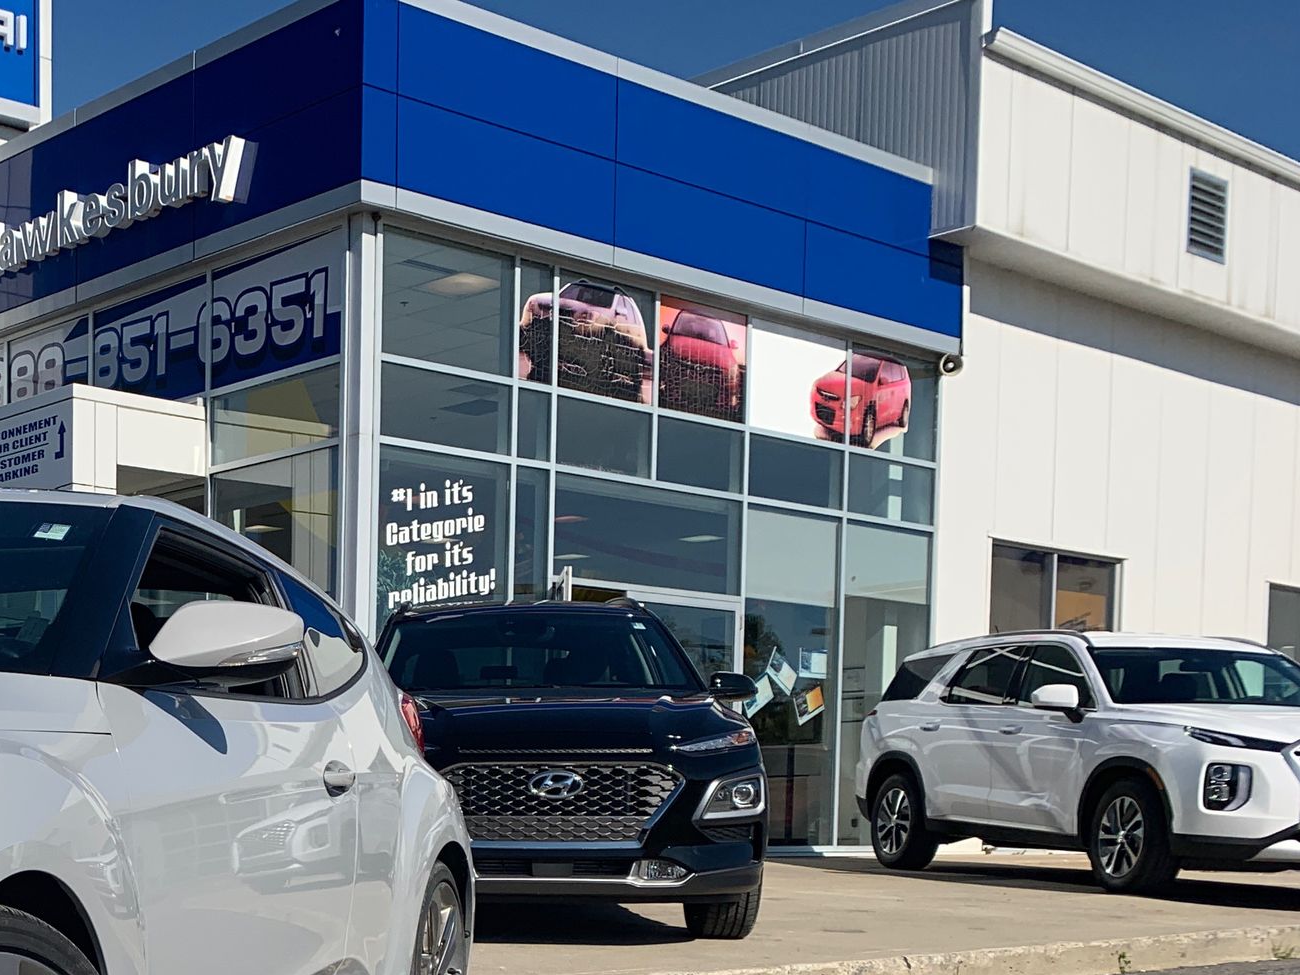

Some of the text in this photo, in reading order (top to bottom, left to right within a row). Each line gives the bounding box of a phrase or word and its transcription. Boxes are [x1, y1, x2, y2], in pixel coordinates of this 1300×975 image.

[12, 431, 48, 450] CLIENT
[391, 479, 474, 511] #1 in it's
[386, 507, 485, 546] Categorie
[406, 541, 474, 577] for it's
[388, 568, 496, 609] reliability!
